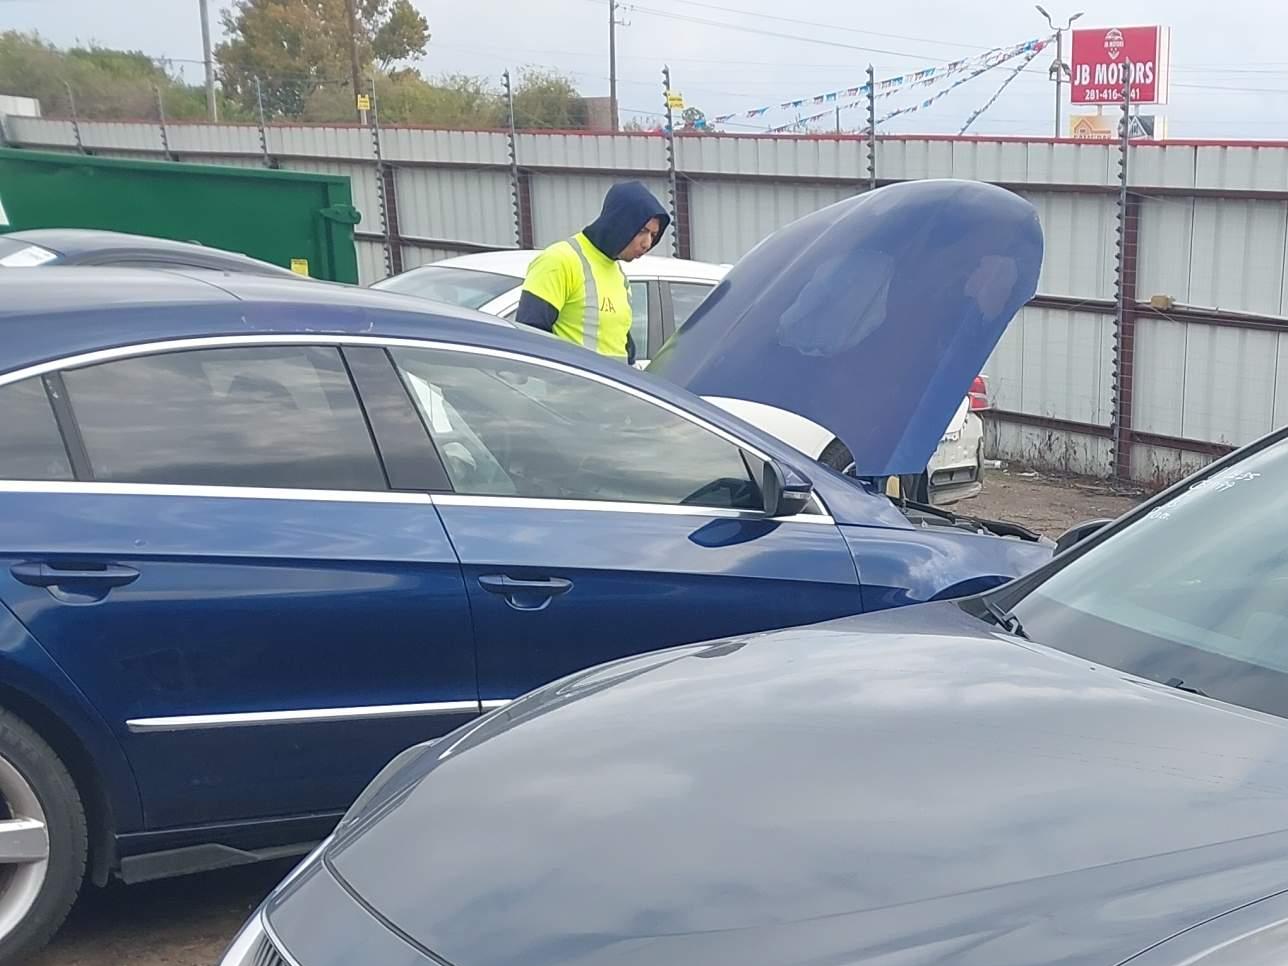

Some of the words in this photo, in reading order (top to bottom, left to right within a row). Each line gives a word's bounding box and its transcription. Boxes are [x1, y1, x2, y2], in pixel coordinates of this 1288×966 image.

[1074, 64, 1090, 86] JB
[1094, 62, 1154, 85] MOTORS
[1085, 88, 1140, 101] 281-416-41
